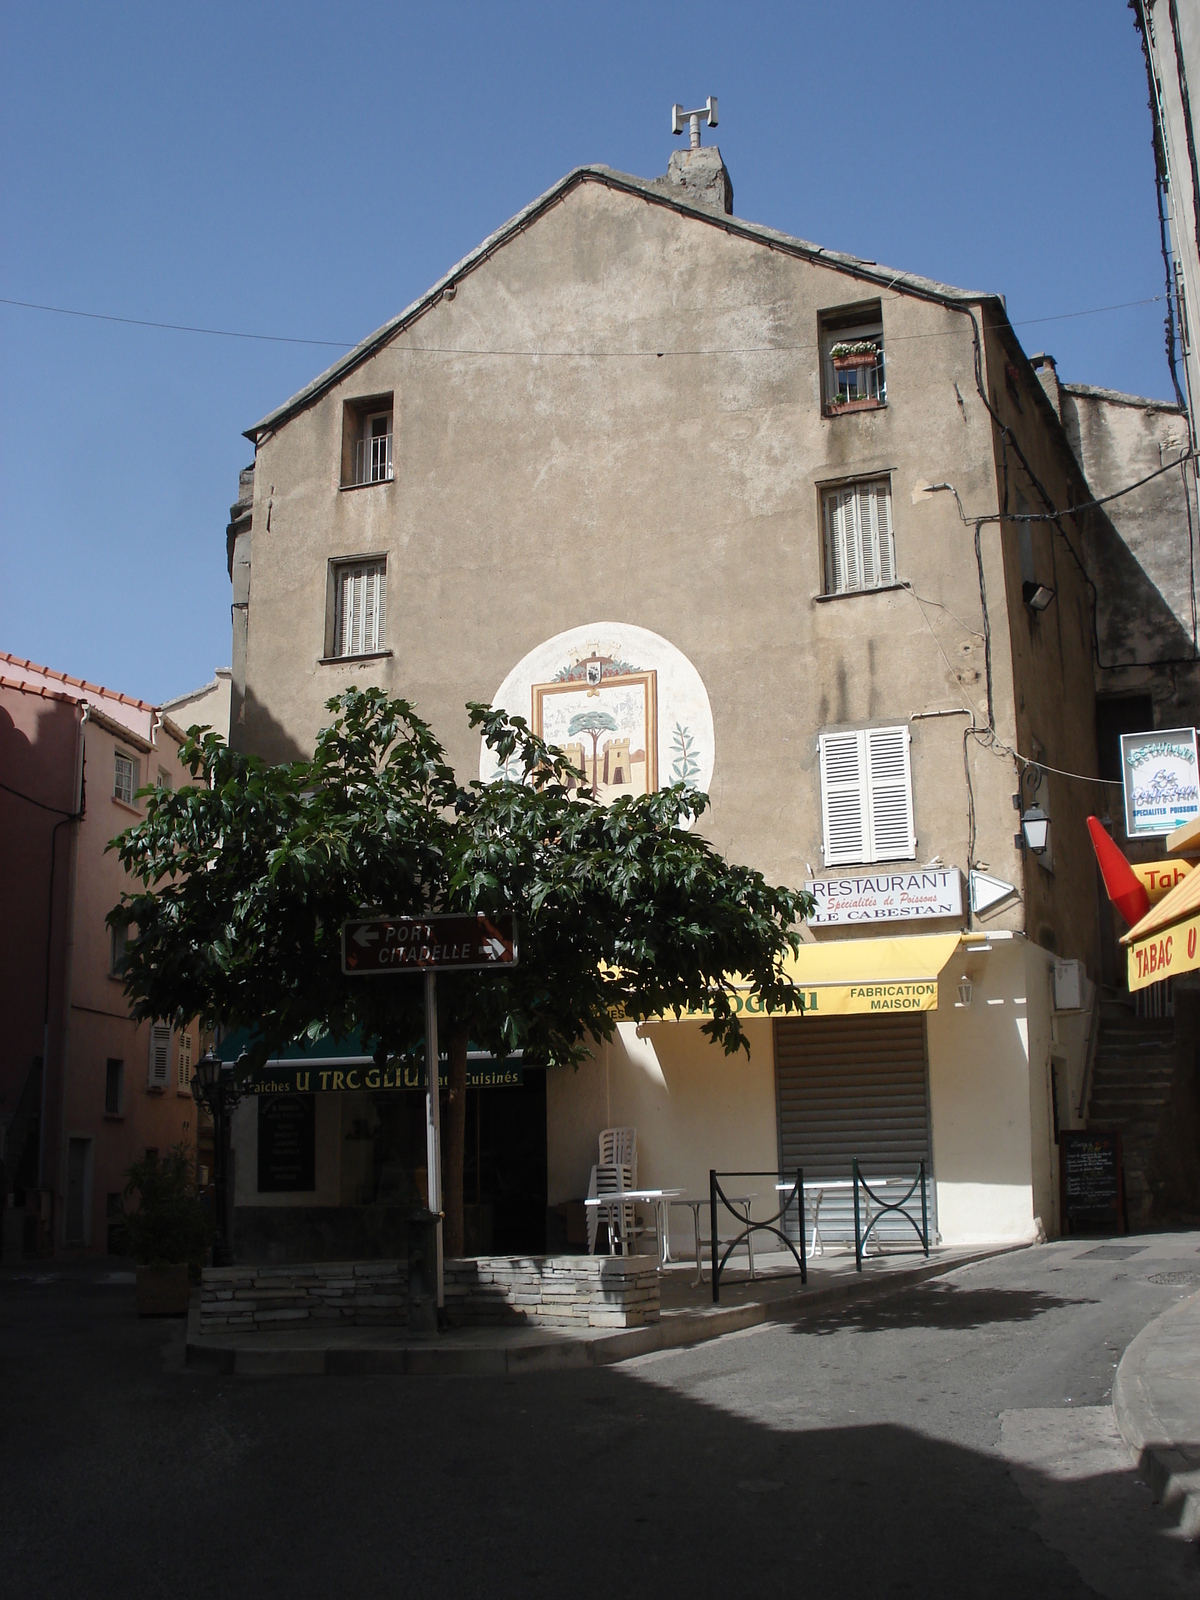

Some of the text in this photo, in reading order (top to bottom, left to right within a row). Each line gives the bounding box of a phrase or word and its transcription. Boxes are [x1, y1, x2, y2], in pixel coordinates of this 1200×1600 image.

[1133, 804, 1198, 818] SPECIALITES POISSONS
[812, 871, 951, 898] RESTAURANT
[827, 892, 937, 912] Spécialités de Poissons
[815, 904, 953, 923] LE CABESTAN
[385, 925, 434, 943] PORT
[379, 943, 471, 964] CITADELLE
[1135, 935, 1173, 979] TABAC
[850, 985, 935, 998] FABRICATION
[870, 999, 921, 1010] MAISON
[247, 1080, 291, 1094] raîches
[295, 1071, 311, 1092] U
